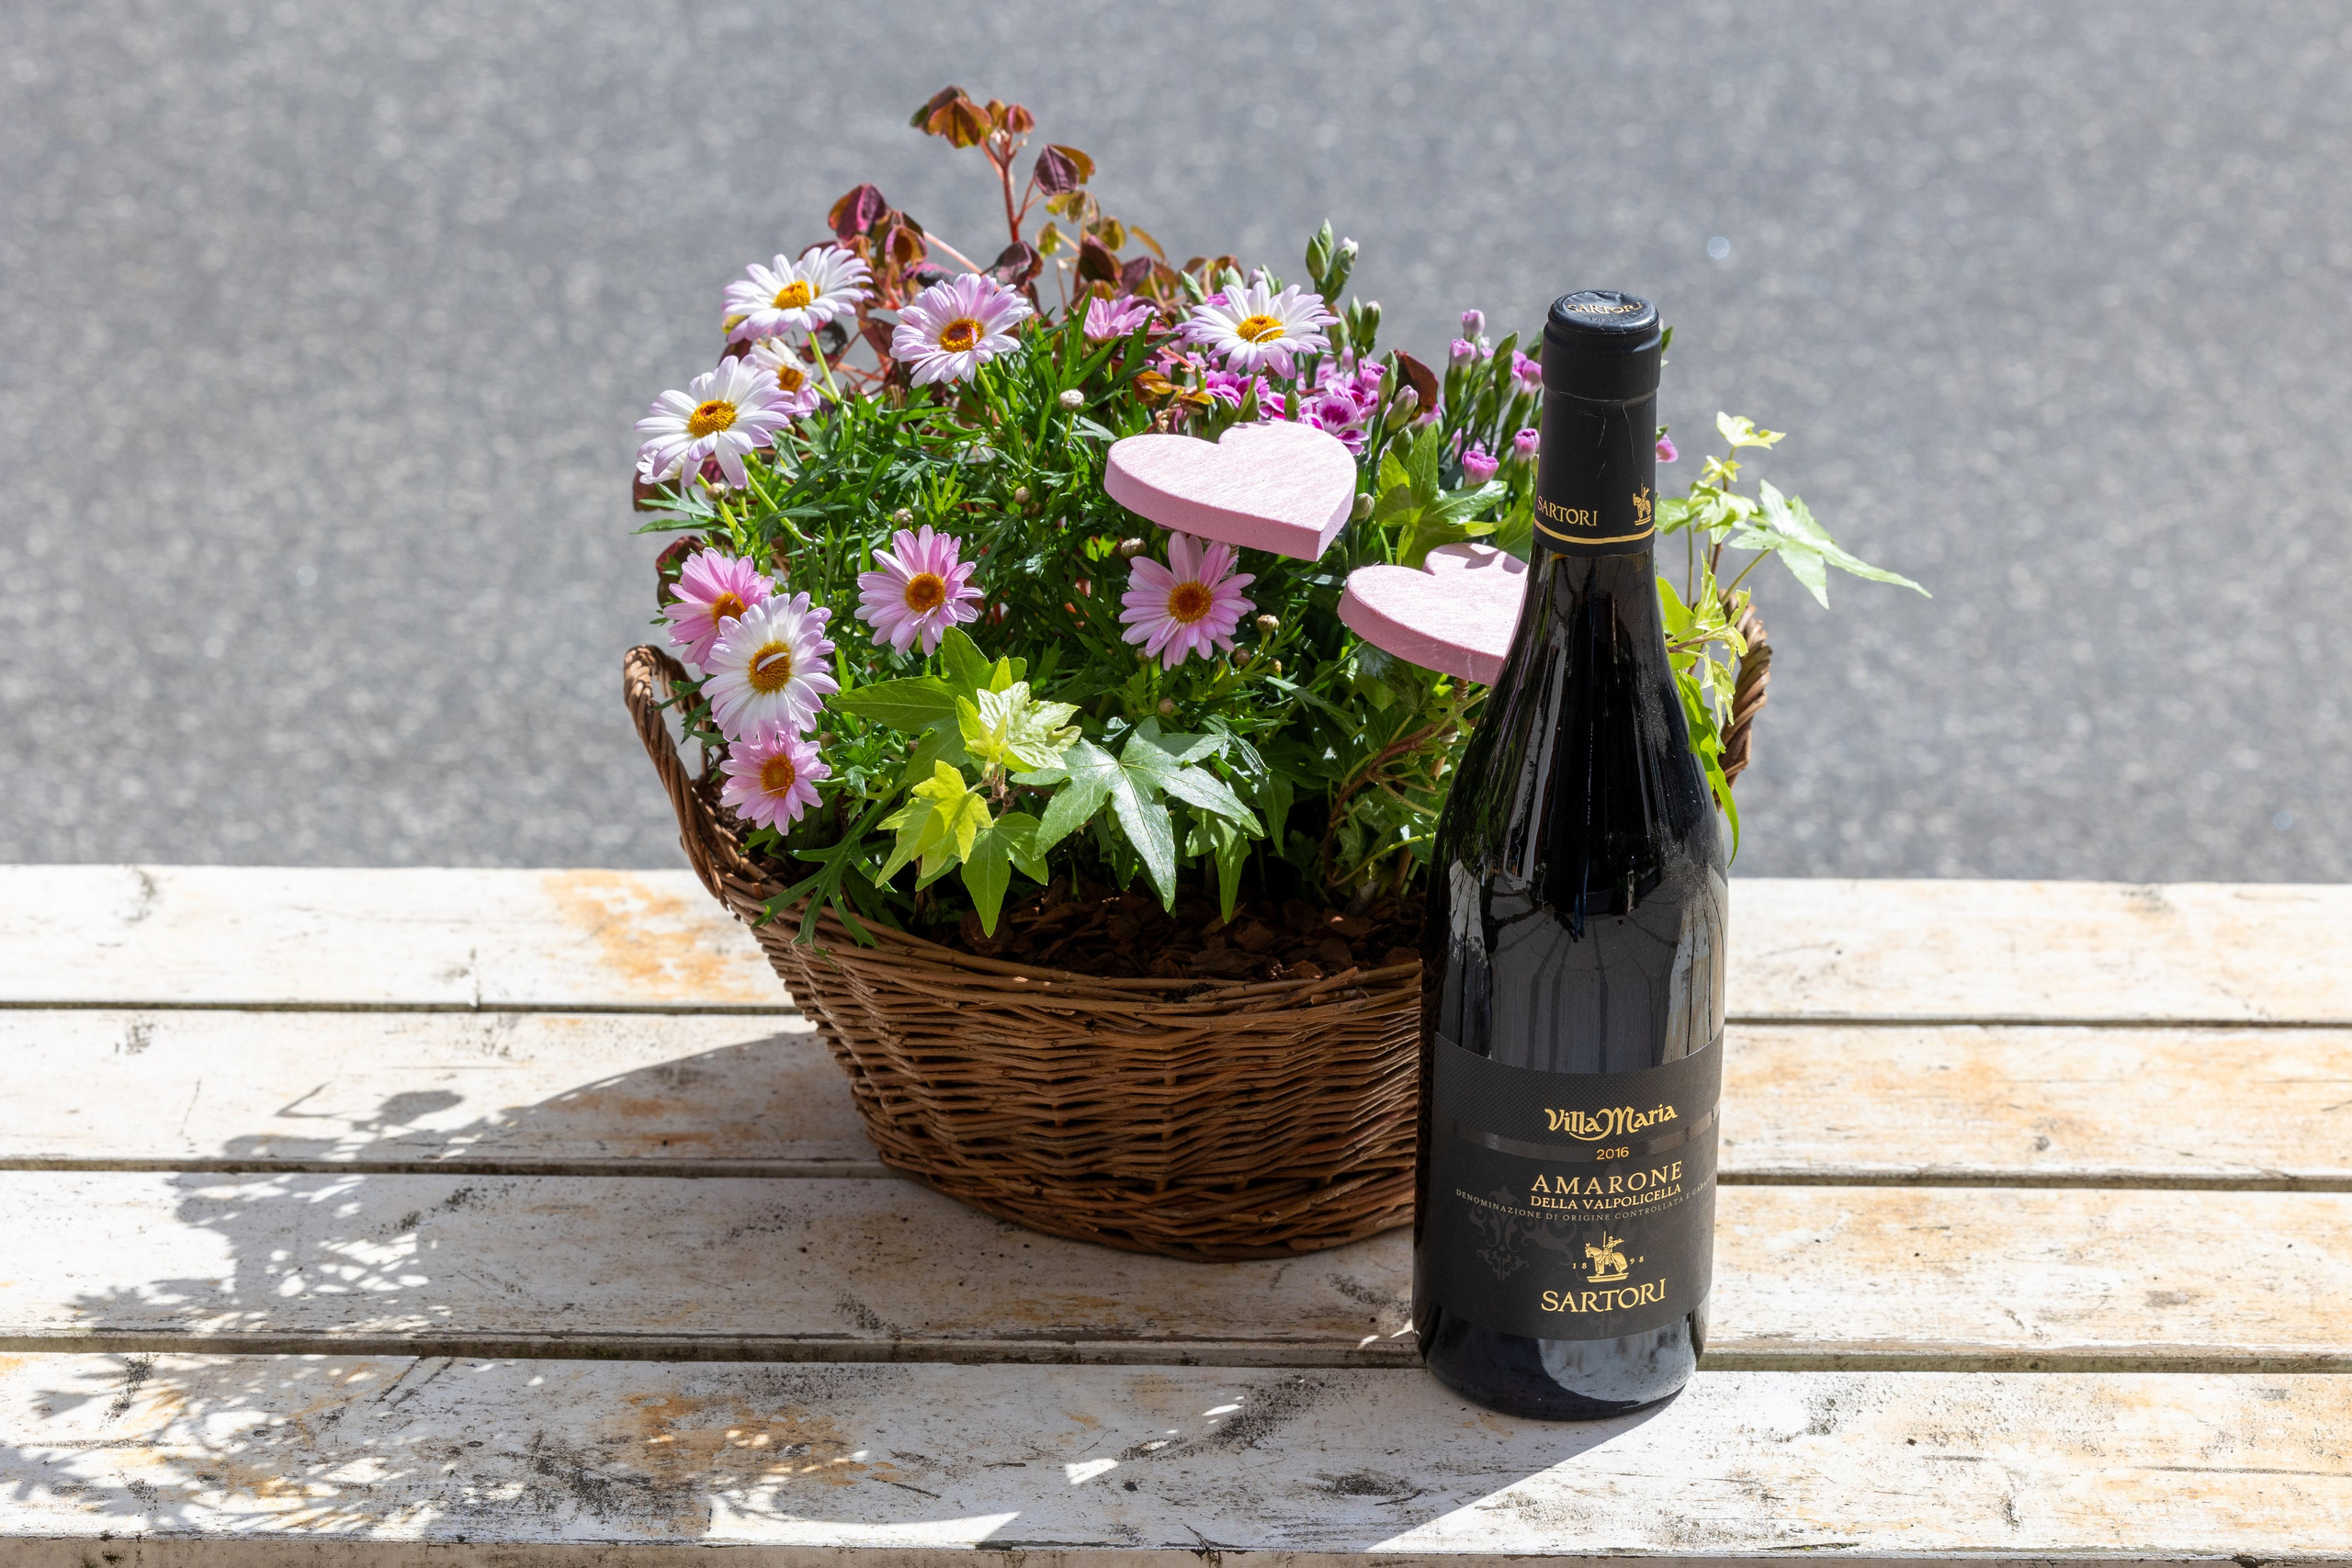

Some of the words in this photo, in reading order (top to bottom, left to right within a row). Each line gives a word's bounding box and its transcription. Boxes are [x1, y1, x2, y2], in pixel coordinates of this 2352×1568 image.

[1567, 301, 1644, 314] SARTORI
[1537, 496, 1598, 526] SARTORI
[1544, 1108, 1603, 1134] Villa
[1569, 1103, 1679, 1141] Maria
[1596, 1146, 1630, 1160] 2016
[1531, 1160, 1682, 1195] AMARONE
[1456, 1189, 1542, 1219] DENOMINAZIONE
[1545, 1213, 1557, 1221] DI
[1562, 1213, 1611, 1222] ORIGINE
[1614, 1196, 1683, 1220] CONTROLLATA
[1530, 1195, 1578, 1210] DELLA
[1582, 1183, 1681, 1210] VALPOLICELLA
[1541, 1278, 1667, 1314] SARTORI
